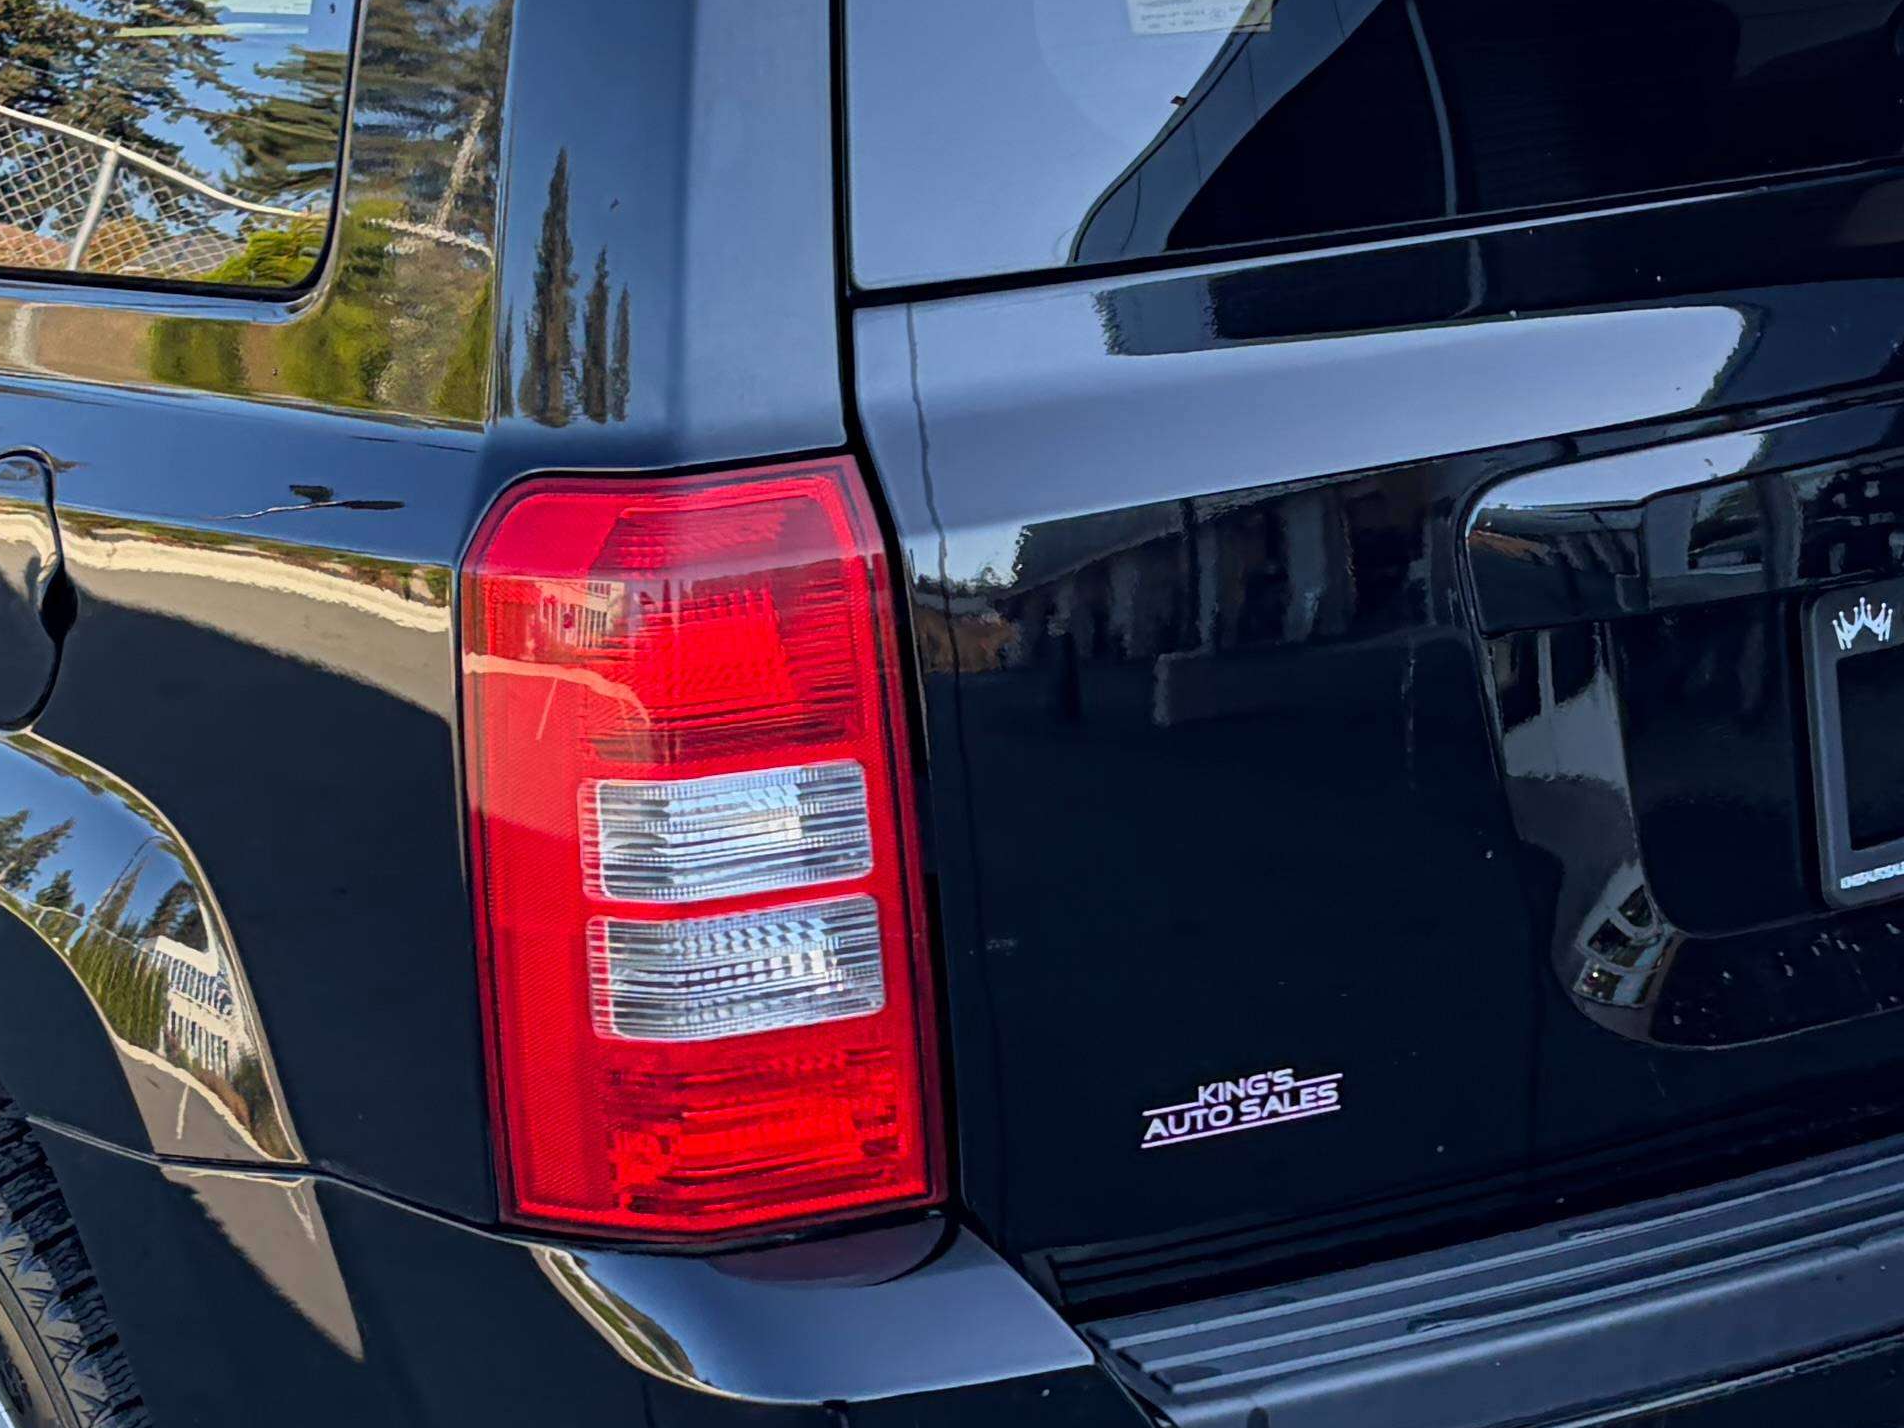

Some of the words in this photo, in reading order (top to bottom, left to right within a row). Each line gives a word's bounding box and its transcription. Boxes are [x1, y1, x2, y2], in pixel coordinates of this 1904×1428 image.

[1144, 1105, 1233, 1140] AUTO
[1239, 1083, 1339, 1122] SALES
[1196, 1068, 1295, 1107] KING'S
